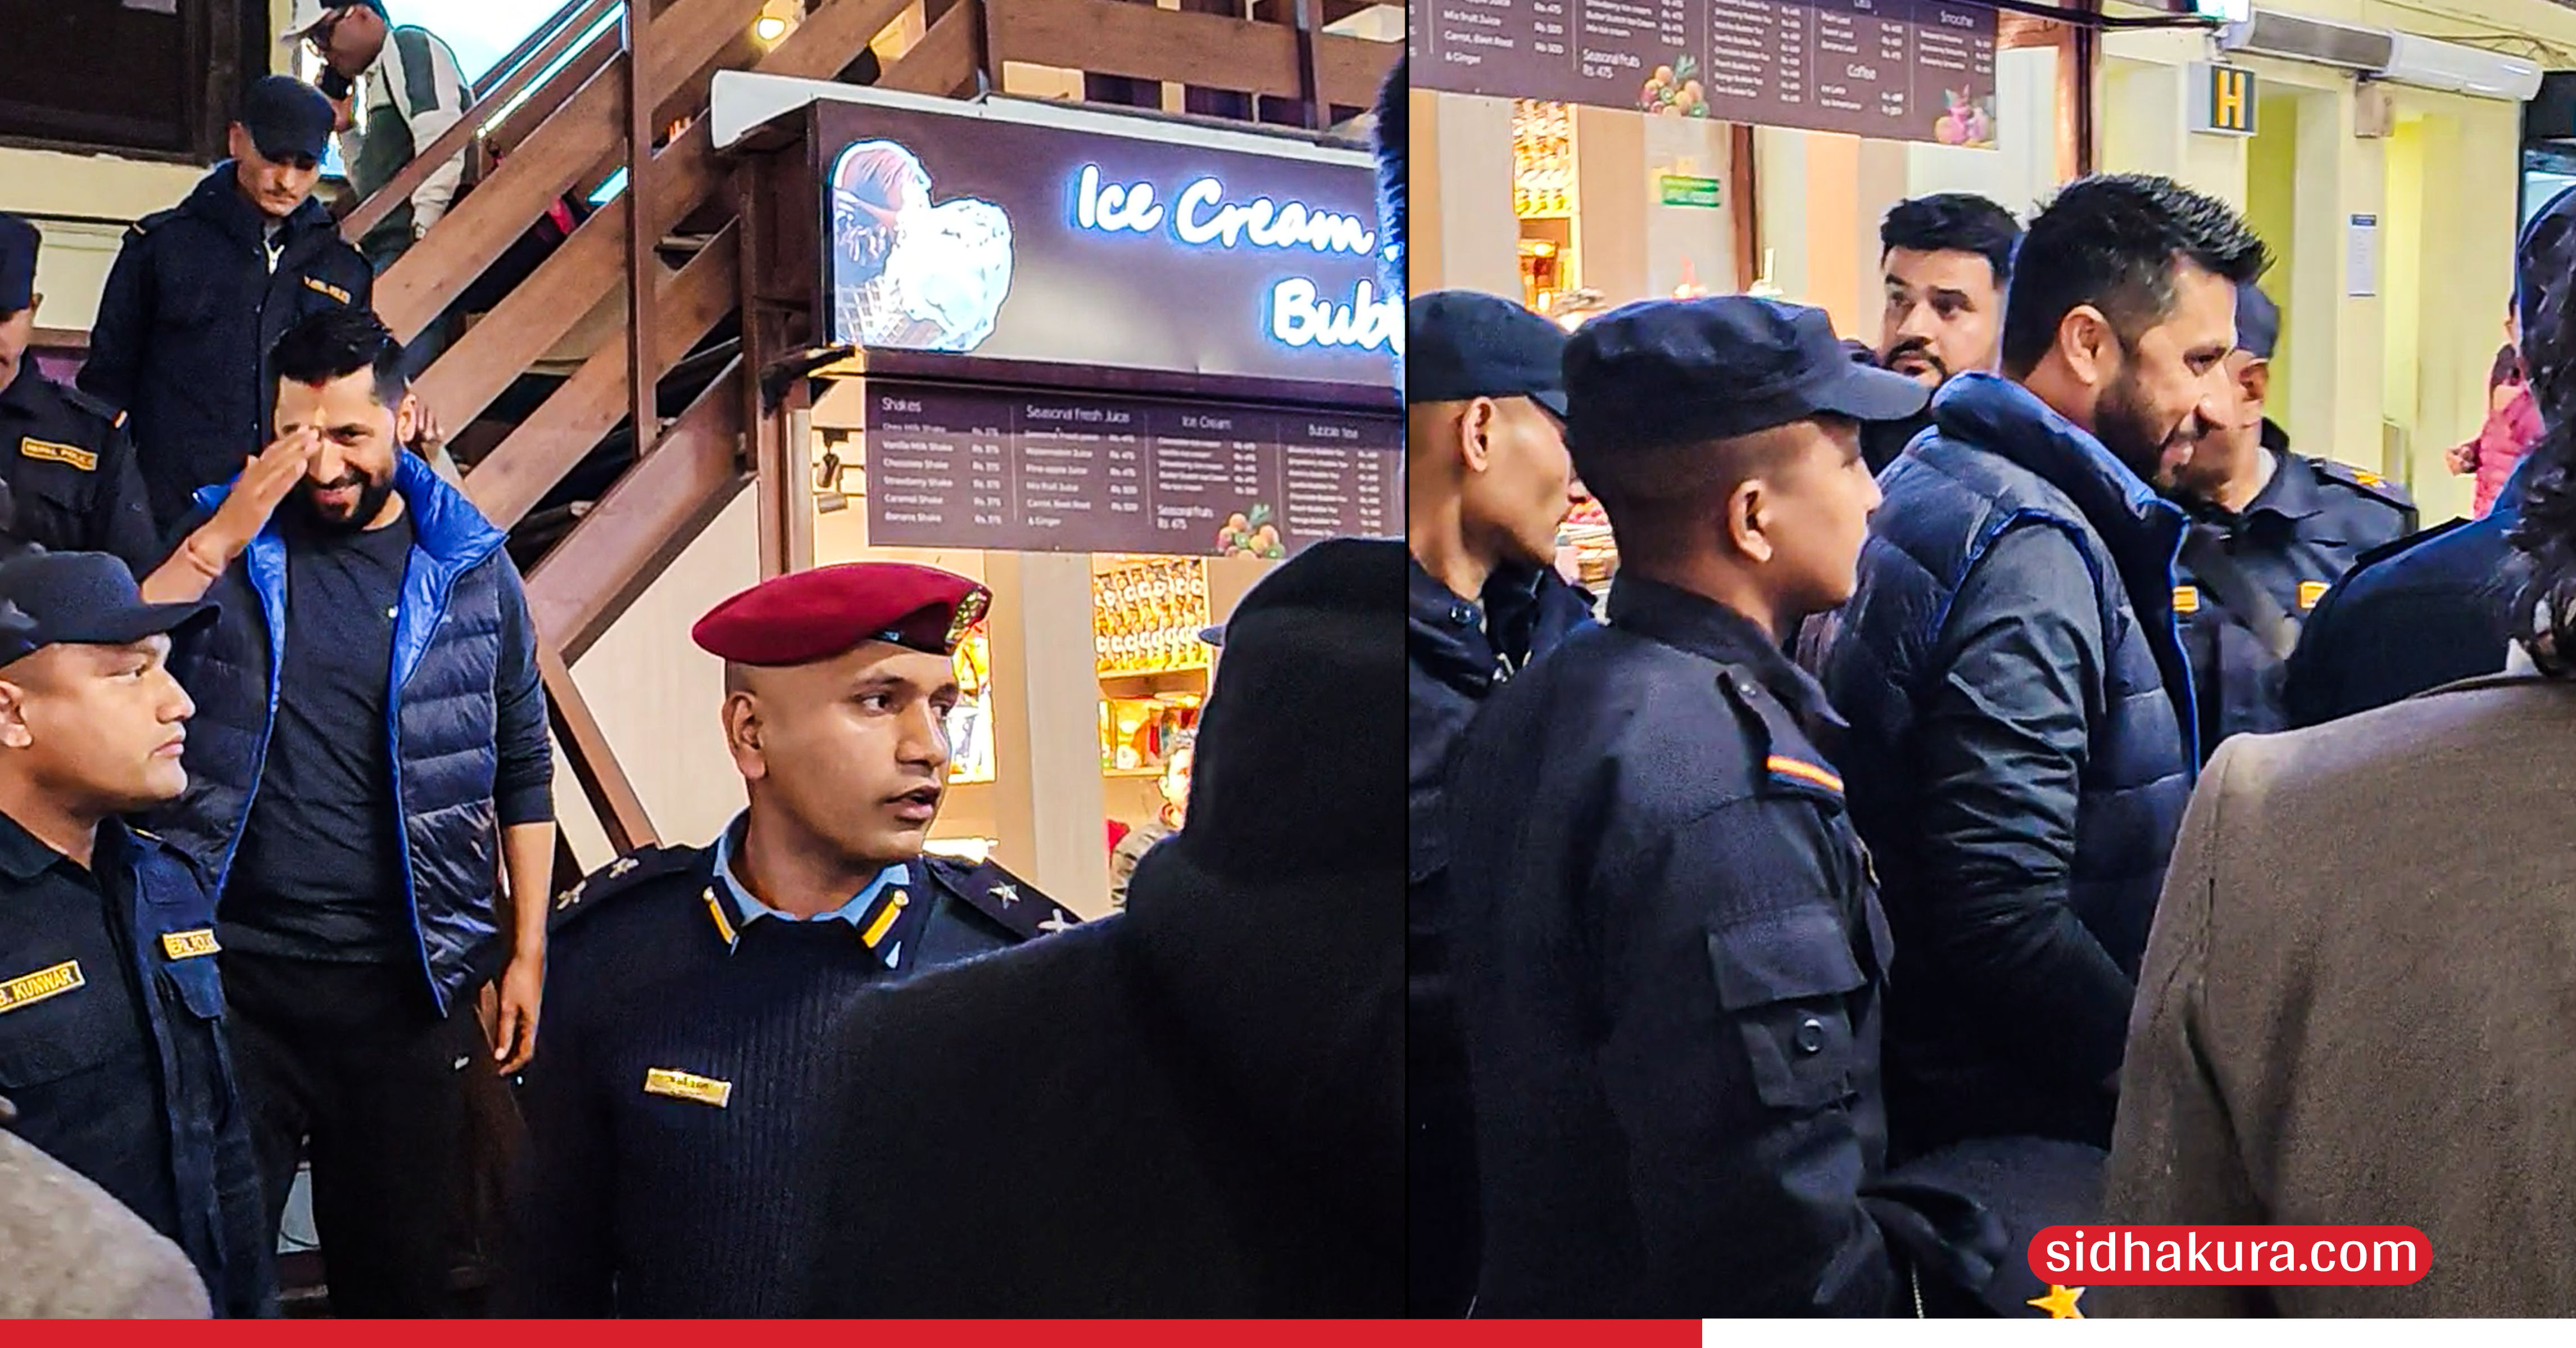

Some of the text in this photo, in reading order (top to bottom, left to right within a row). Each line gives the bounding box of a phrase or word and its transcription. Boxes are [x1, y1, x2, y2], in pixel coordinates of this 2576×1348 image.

[1846, 63, 1876, 80] Coffee
[2218, 70, 2245, 129] H
[1077, 164, 1375, 255] Ice Cream
[1273, 277, 1405, 355] Bub
[882, 397, 921, 412] Shakes
[14, 968, 74, 1000] KUNWAR
